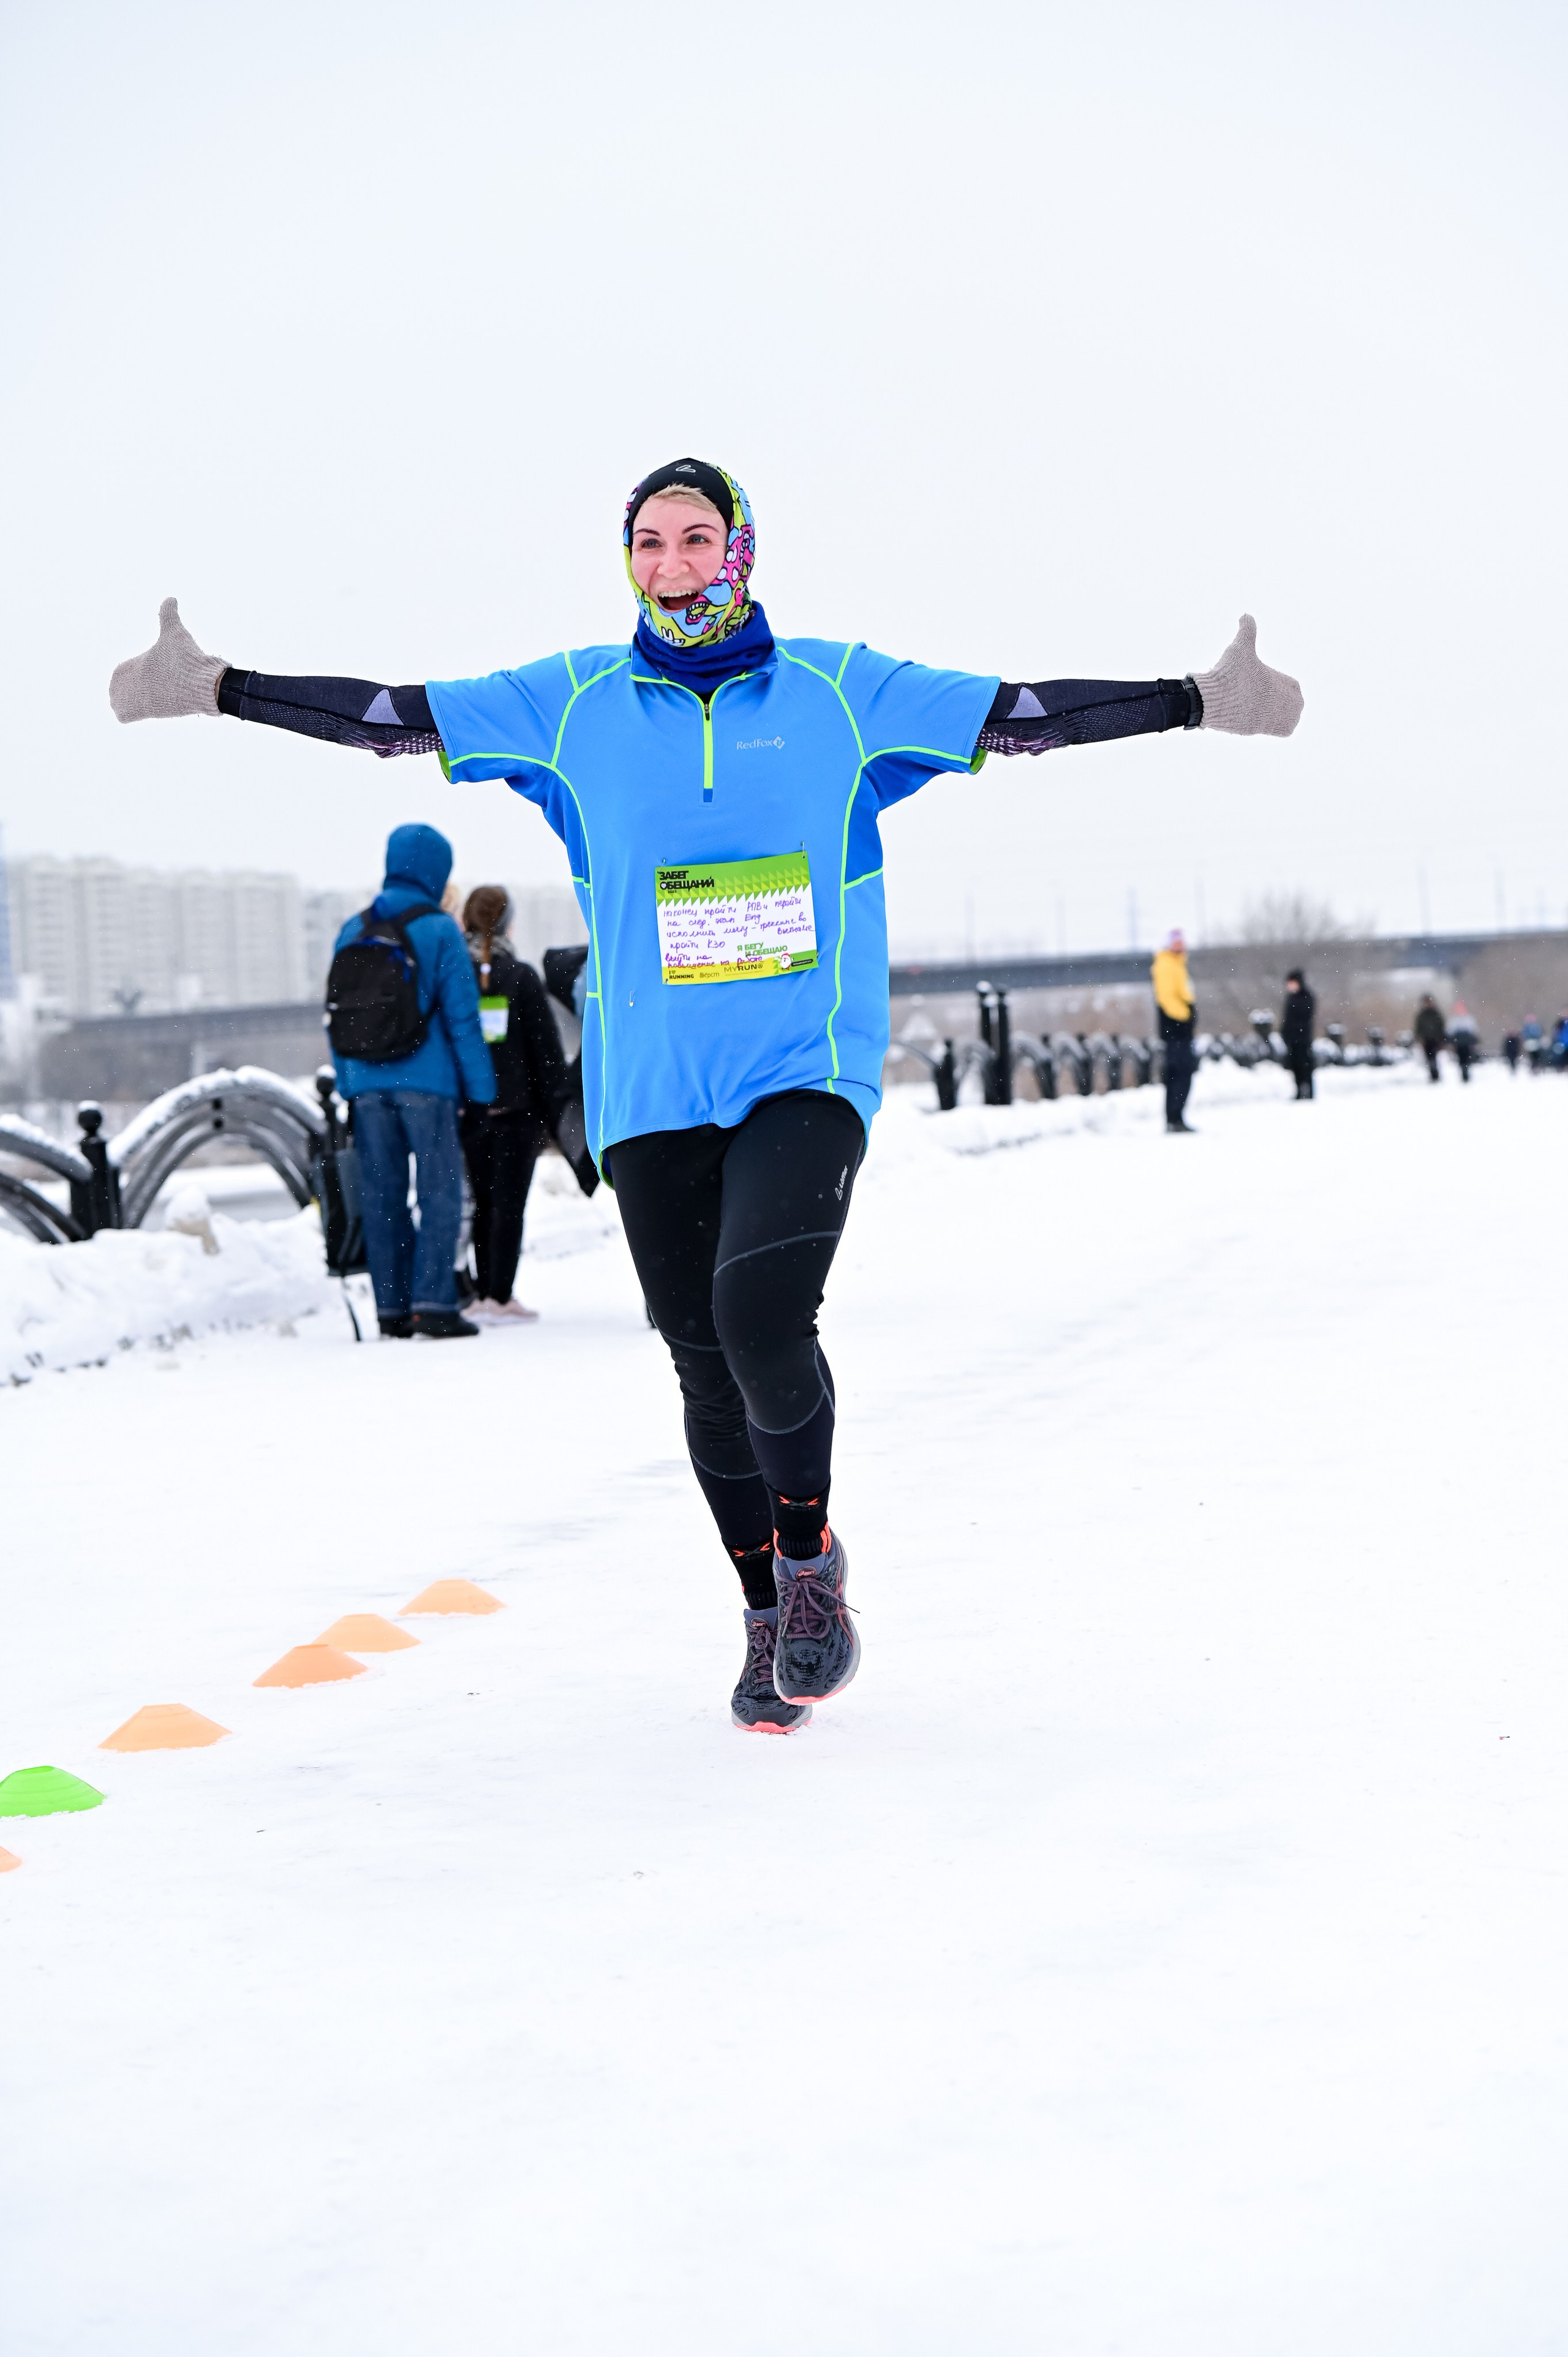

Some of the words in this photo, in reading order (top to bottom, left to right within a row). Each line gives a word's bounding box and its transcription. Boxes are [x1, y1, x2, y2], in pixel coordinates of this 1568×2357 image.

[660, 870, 689, 880] ЗАБЕГ
[660, 876, 715, 892] ОБЕЩАНИЙ
[744, 941, 764, 951] БЕГУ
[753, 945, 788, 956] ОБЕЩАЮ
